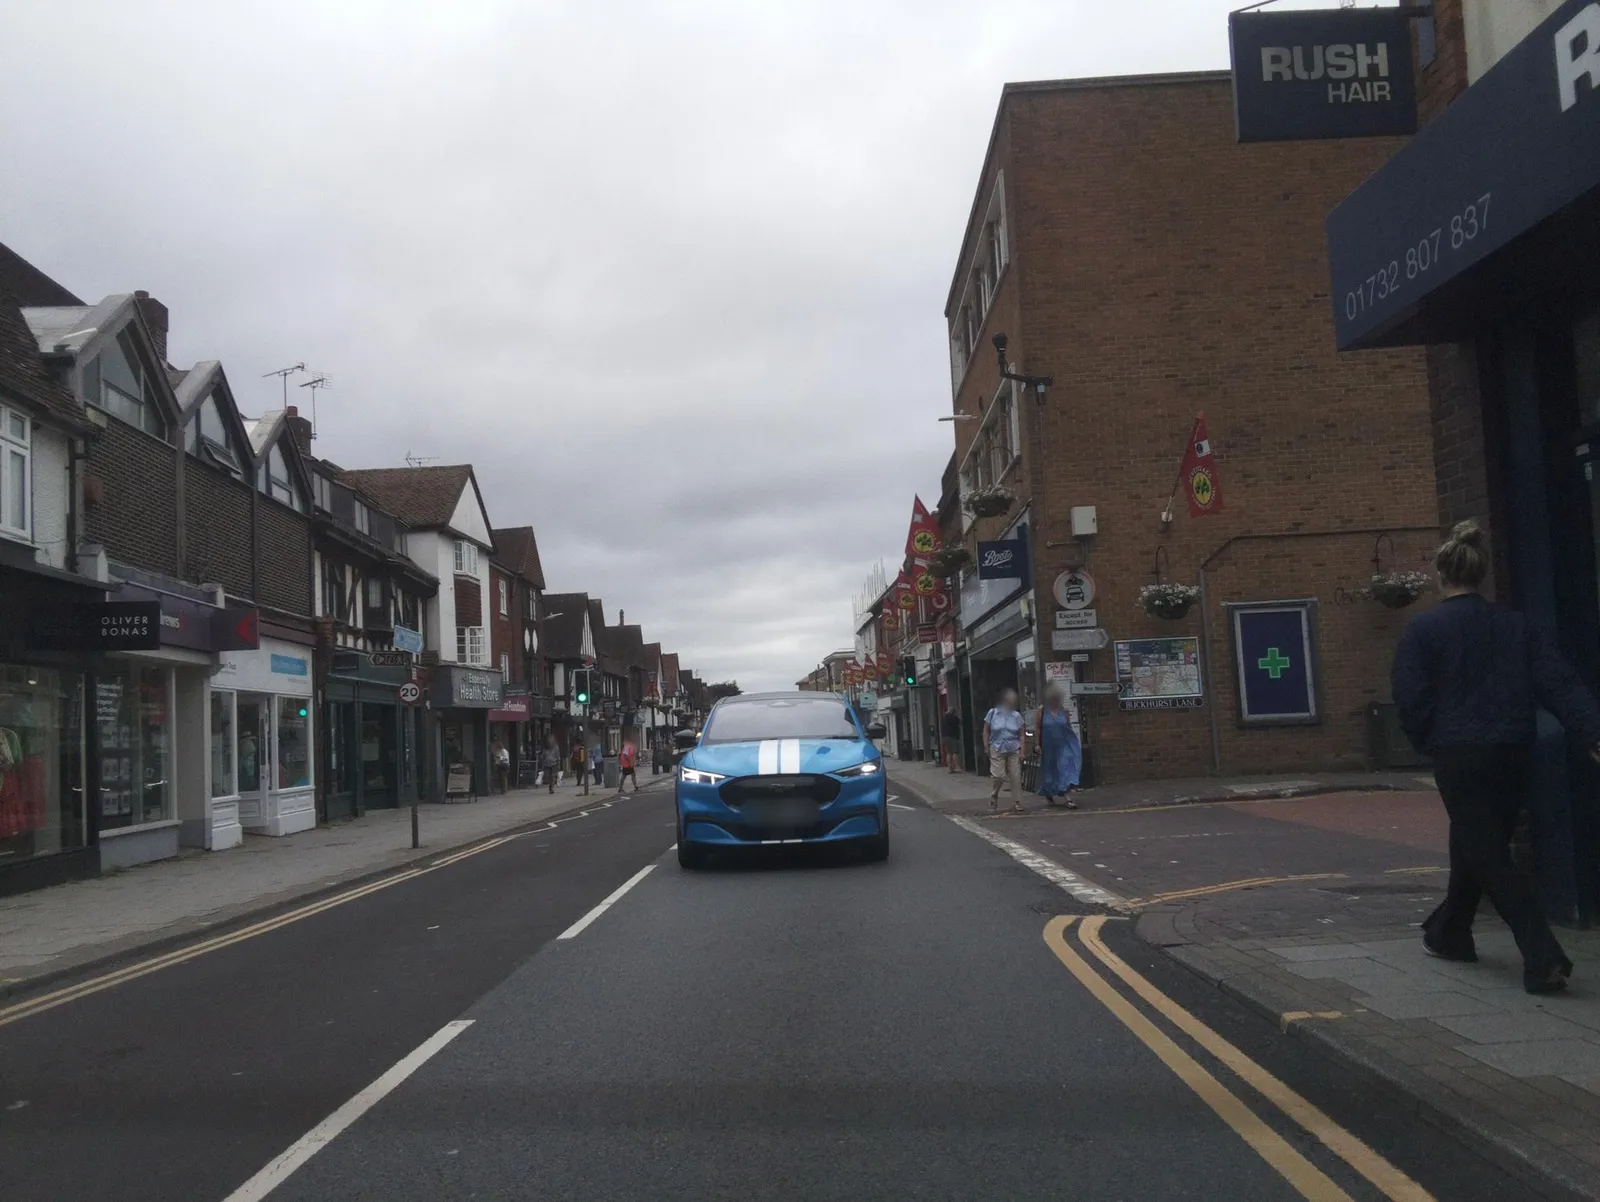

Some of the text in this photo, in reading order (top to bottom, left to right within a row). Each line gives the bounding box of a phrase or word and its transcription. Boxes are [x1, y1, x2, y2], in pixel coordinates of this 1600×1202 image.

[1261, 42, 1389, 81] RUSH
[1328, 81, 1391, 104] HAIR
[1346, 191, 1492, 320] 01732 807 837
[101, 616, 149, 625] OLIVER
[1059, 612, 1081, 620] Except
[101, 627, 149, 636] BONAS
[401, 687, 418, 697] 20
[460, 684, 482, 701] Health
[482, 686, 499, 702] Store
[1125, 698, 1197, 709] BUCKHURST LANE
